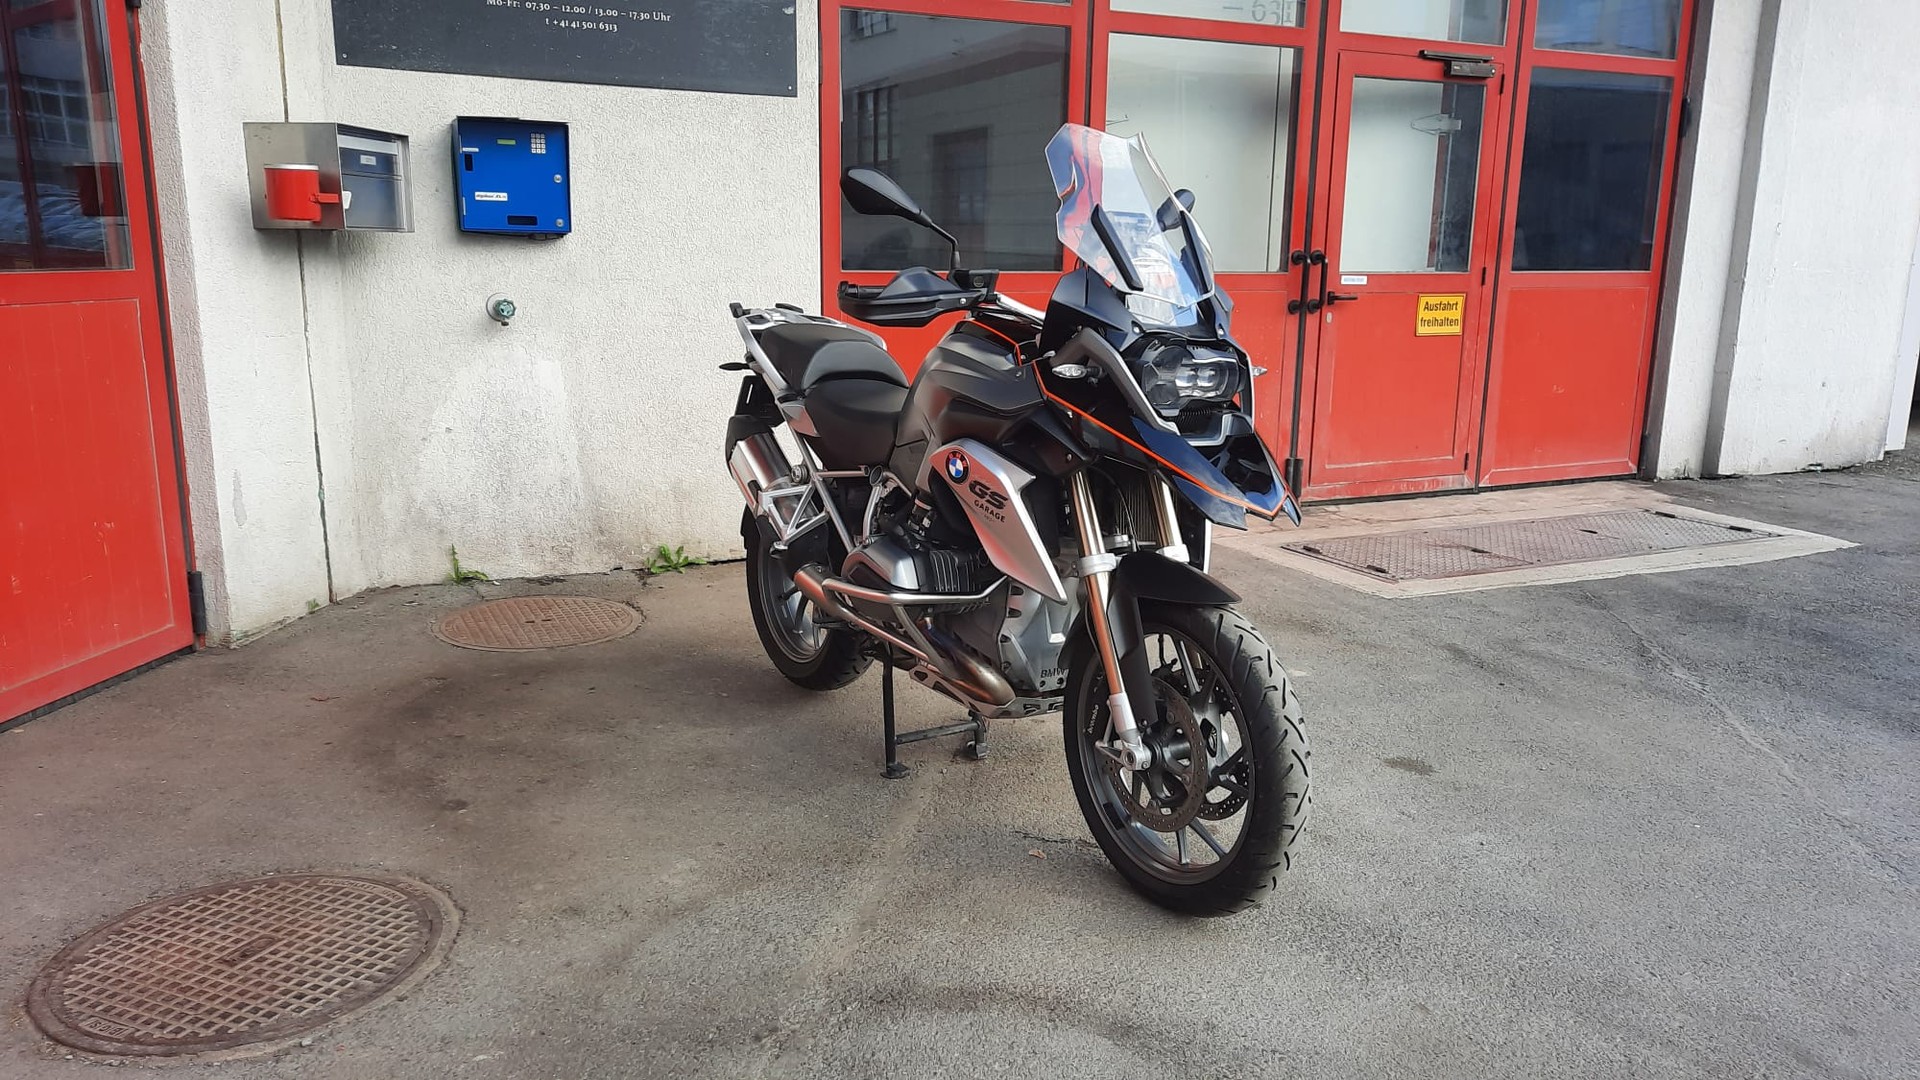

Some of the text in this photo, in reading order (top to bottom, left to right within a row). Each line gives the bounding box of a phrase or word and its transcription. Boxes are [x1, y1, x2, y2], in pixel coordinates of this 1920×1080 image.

[525, 1, 550, 11] 07.30
[562, 4, 586, 13] 12.00
[595, 8, 618, 17] 13.00
[629, 11, 650, 20] 17.30
[653, 11, 671, 21] Uhr
[582, 21, 597, 30] 501
[599, 21, 618, 32] 6313
[1423, 300, 1459, 312] Ausfahrt
[1420, 316, 1459, 328] freihalten
[969, 480, 1008, 510] GS
[974, 499, 1006, 522] GARAGE
[1041, 667, 1067, 678] BMW
